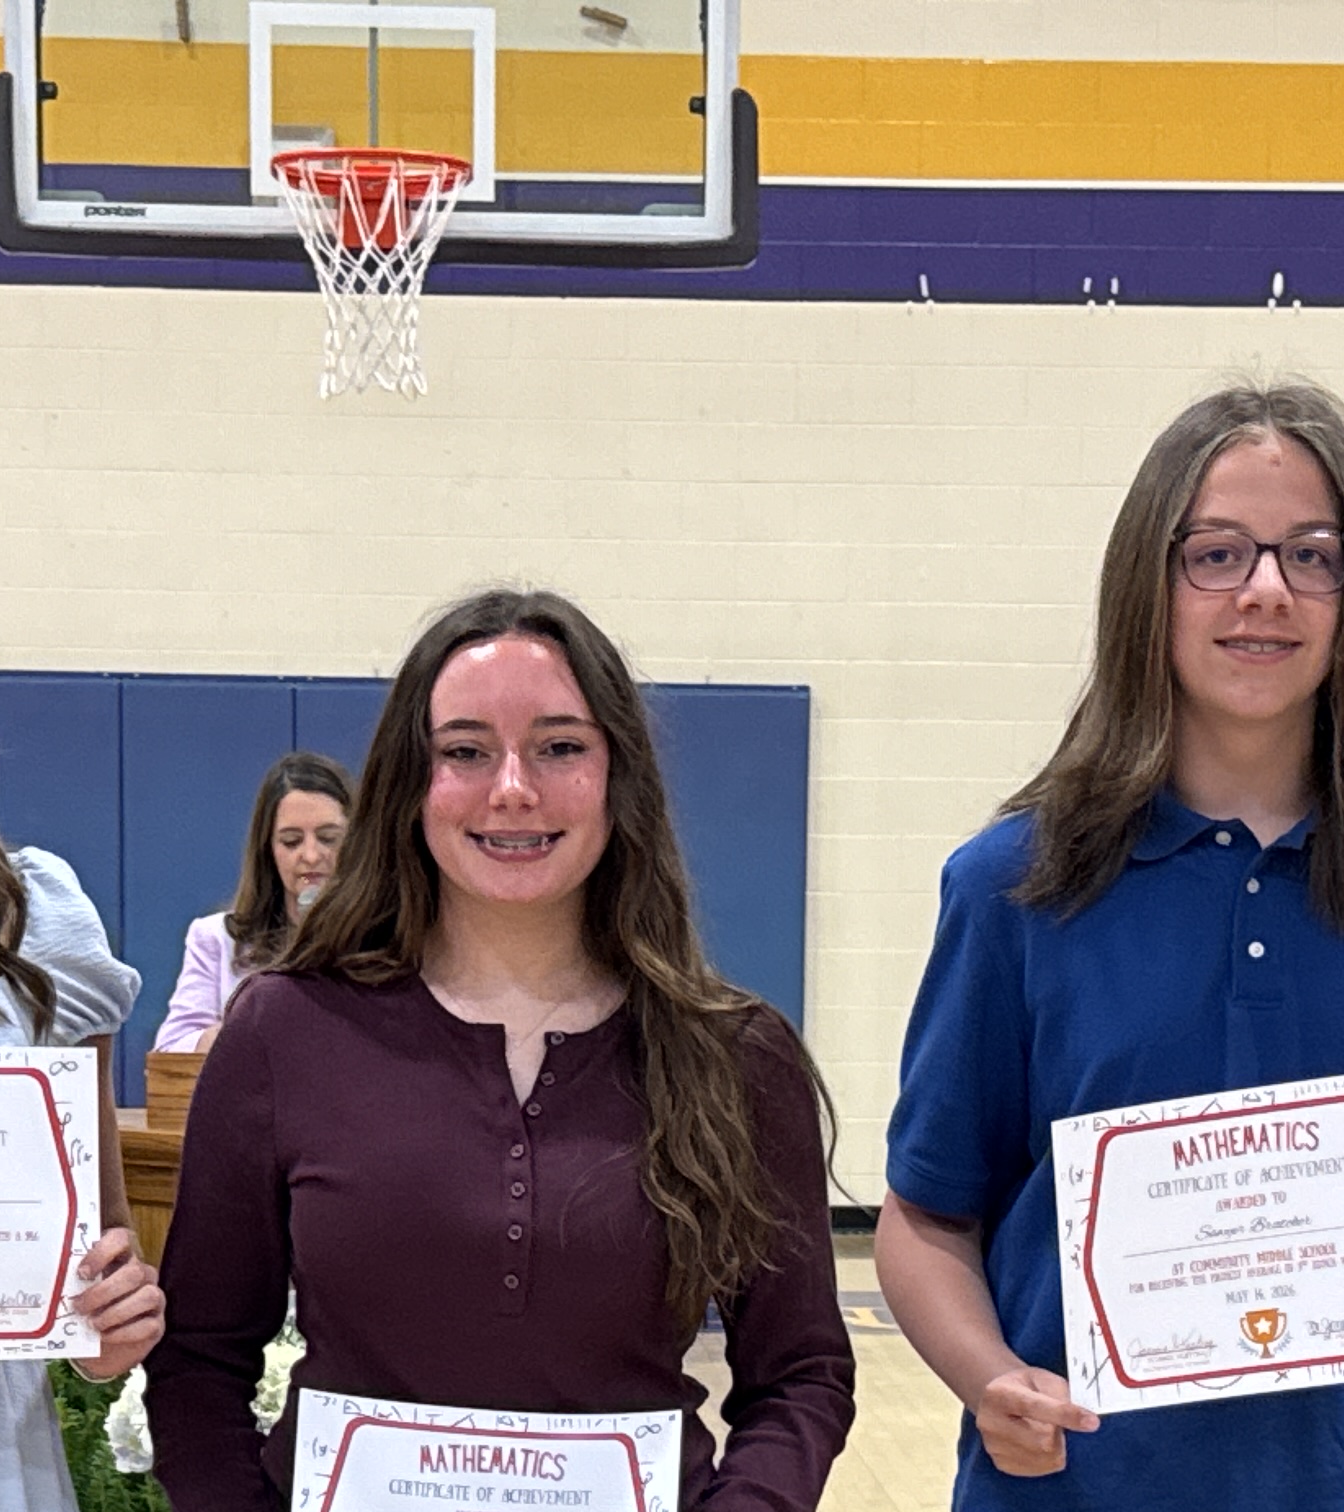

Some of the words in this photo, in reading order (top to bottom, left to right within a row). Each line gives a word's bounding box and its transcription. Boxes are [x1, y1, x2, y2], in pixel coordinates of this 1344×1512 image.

[1172, 1121, 1320, 1171] MATHEMATICS
[1147, 1171, 1229, 1199] CERTIFICATE
[1235, 1169, 1252, 1186] OF
[1271, 1191, 1287, 1205] TO
[419, 1443, 567, 1482] MATHEMATICS
[389, 1479, 470, 1502] CERTIFICATE
[476, 1487, 495, 1502] OF
[501, 1488, 592, 1506] ACHIEVEMENT
